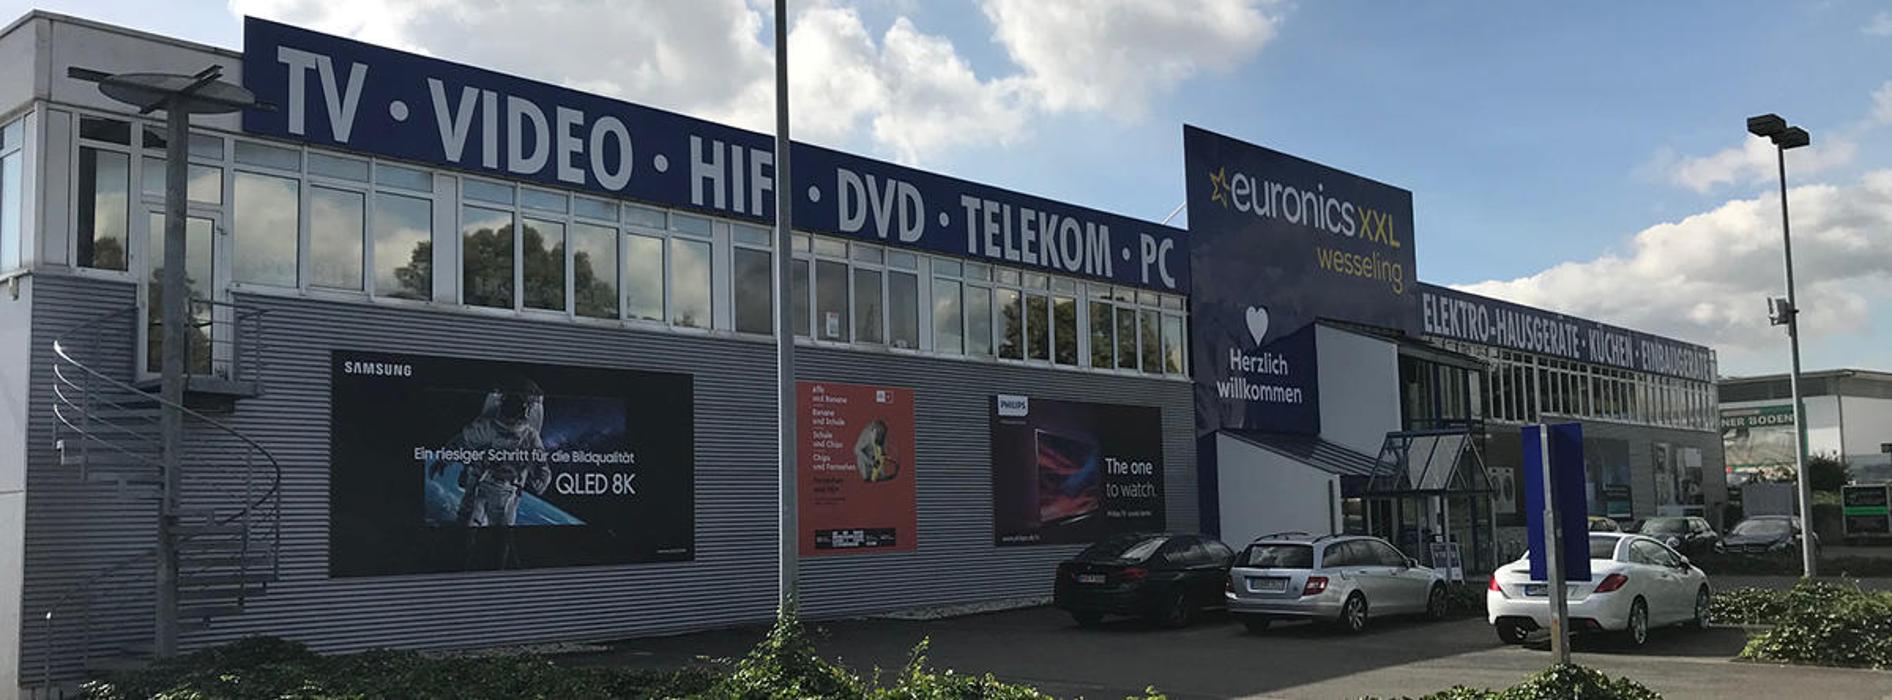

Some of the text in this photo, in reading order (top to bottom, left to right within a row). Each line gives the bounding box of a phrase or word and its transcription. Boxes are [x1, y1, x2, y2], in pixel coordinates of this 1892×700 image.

[277, 45, 1176, 289] TV VIDEO HIF DVD TELEKOM PC
[1230, 172, 1401, 248] euronics XXL
[1317, 247, 1403, 294] wesseling
[1587, 323, 1634, 369] KÜCHEN
[344, 361, 413, 377] SAMSUNG
[1229, 348, 1288, 376] Herzlich
[1216, 377, 1303, 404] willkommen
[1000, 399, 1026, 410] PHILIPS
[414, 447, 635, 466] Ein riesiger Schritt für die Bildqualität
[1105, 458, 1153, 475] The one
[555, 473, 636, 496] QLED 8K
[1106, 482, 1119, 498] to
